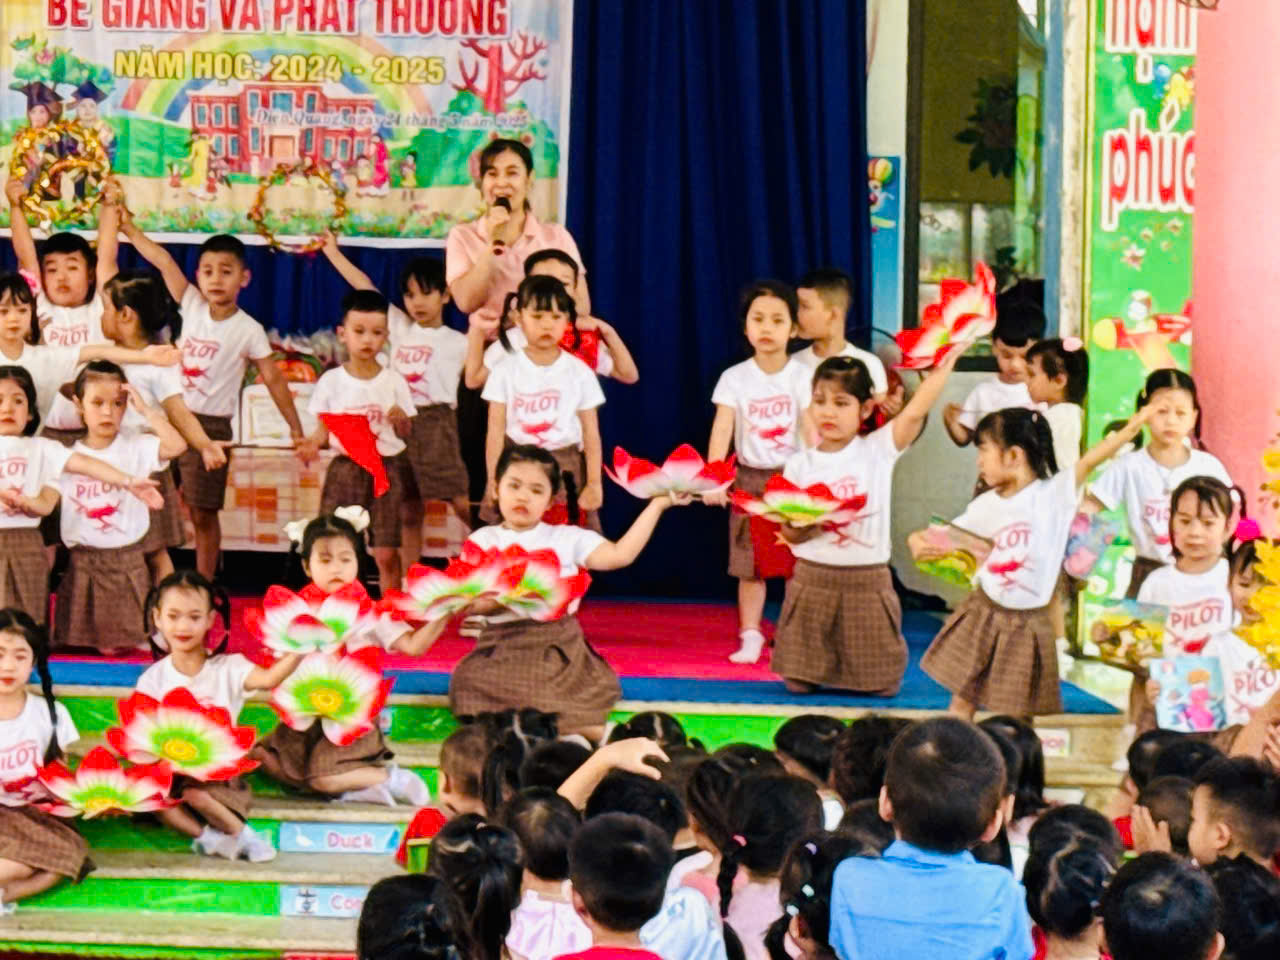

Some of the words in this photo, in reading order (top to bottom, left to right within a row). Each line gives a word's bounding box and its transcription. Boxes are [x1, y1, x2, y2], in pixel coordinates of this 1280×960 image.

[115, 44, 184, 80] NĂM
[192, 52, 263, 87] HỌC:
[271, 53, 343, 83] 2024
[372, 53, 446, 85] 2025
[48, 328, 88, 346] PILOT
[512, 394, 558, 413] PILOT
[747, 399, 791, 419] PILOT
[1170, 606, 1224, 629] PILOT
[327, 831, 374, 848] Duck
